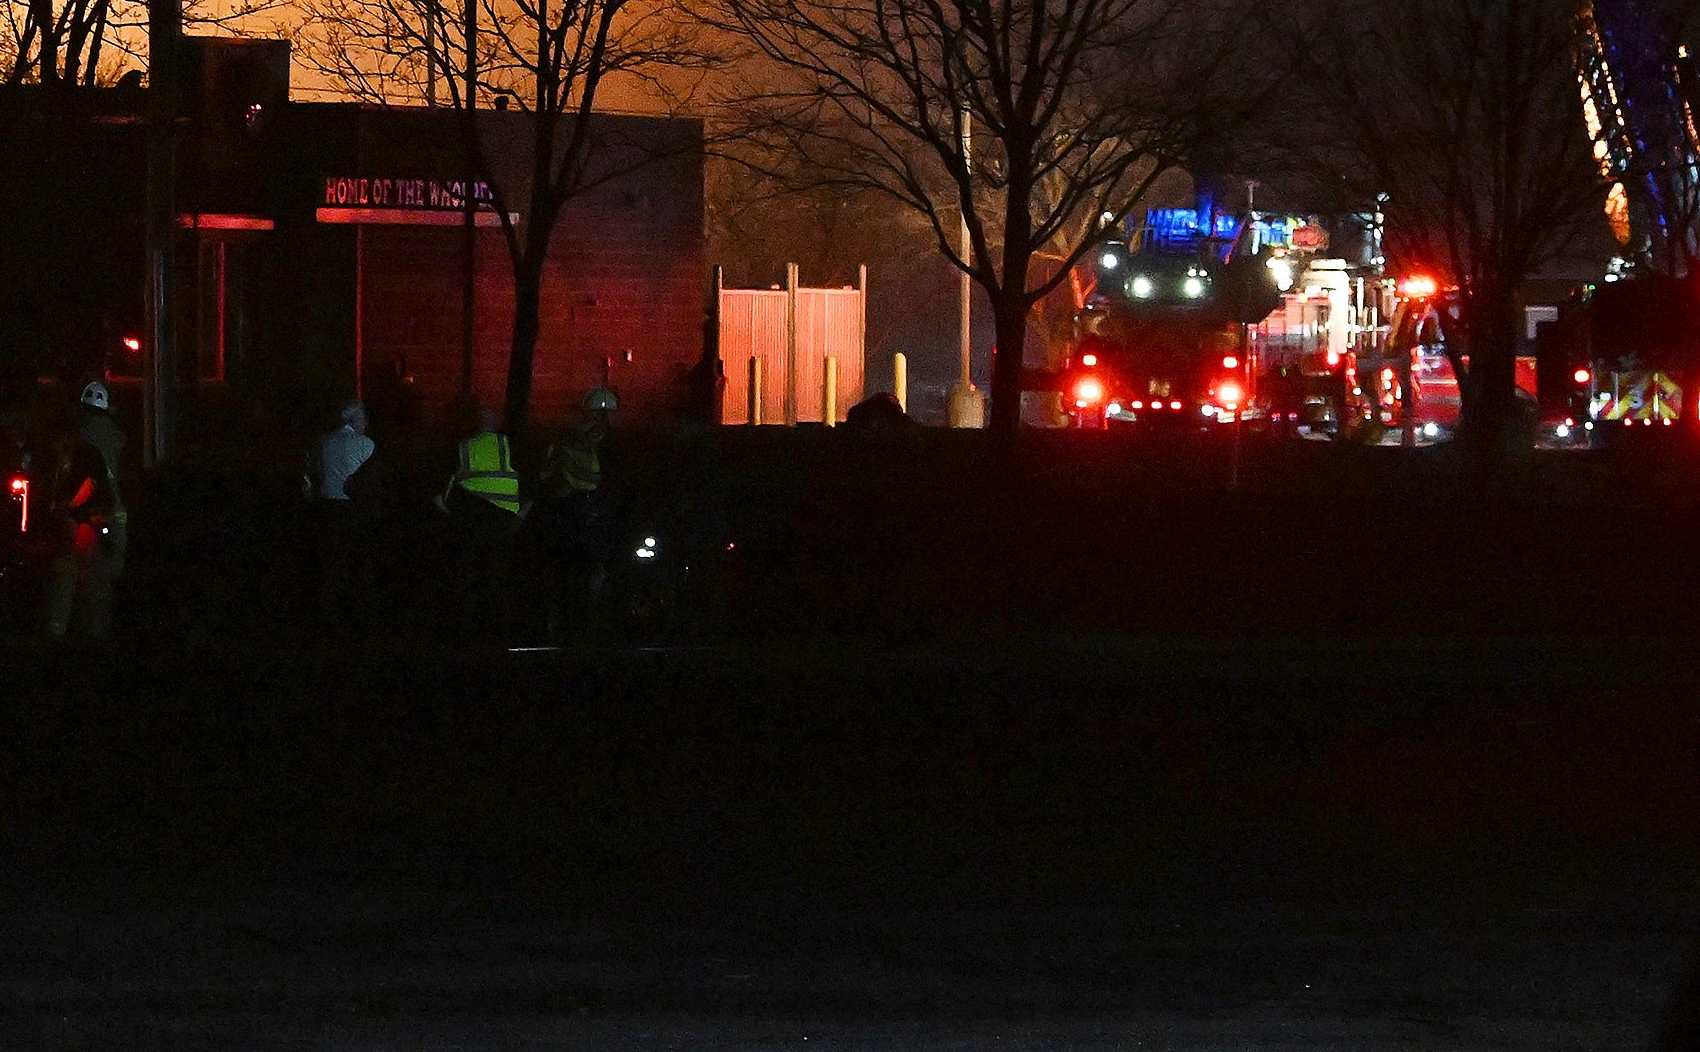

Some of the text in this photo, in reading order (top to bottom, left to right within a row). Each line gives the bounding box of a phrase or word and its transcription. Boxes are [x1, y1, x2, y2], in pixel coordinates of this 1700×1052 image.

[325, 177, 493, 208] HOME OF THE WHOE
